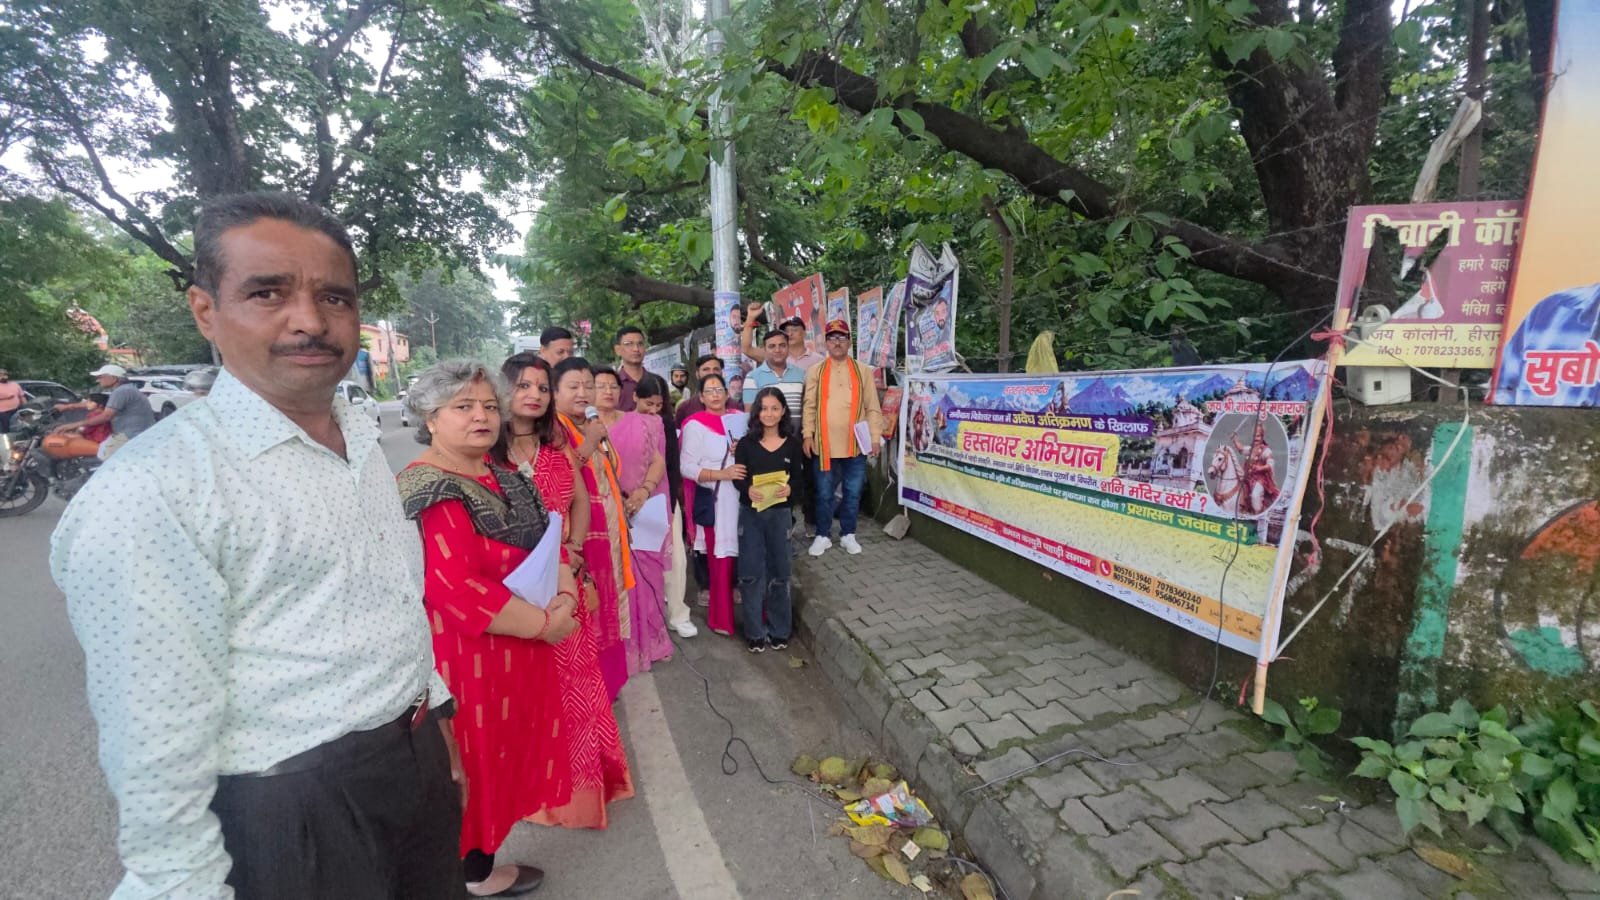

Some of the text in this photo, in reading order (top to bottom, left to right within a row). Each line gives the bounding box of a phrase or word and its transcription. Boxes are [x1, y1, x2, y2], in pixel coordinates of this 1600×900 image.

[1474, 209, 1522, 246] कॉ
[1459, 255, 1484, 273] हमारे
[1480, 279, 1506, 294] लहंगे
[1403, 326, 1457, 342] कॉलोनी,
[1377, 346, 1402, 356] Mob
[1526, 340, 1600, 396] सुबो
[1206, 401, 1221, 413] जय
[1223, 398, 1234, 413] श्री
[1269, 401, 1306, 415] महाराज
[1038, 412, 1093, 429] अतिक्रमण
[1094, 417, 1105, 430] के
[1107, 418, 1149, 433] खिलाफ
[963, 431, 1106, 472] हस्ताक्षर अभियान
[1100, 477, 1124, 495] शनि
[1128, 483, 1161, 502] मंदिर
[1166, 491, 1196, 509] क्यों
[1200, 496, 1208, 512] ?
[1101, 497, 1119, 510] होगा
[1126, 502, 1174, 525] प्रशासन
[1177, 513, 1223, 535] जवाब
[1065, 551, 1091, 568] समाज
